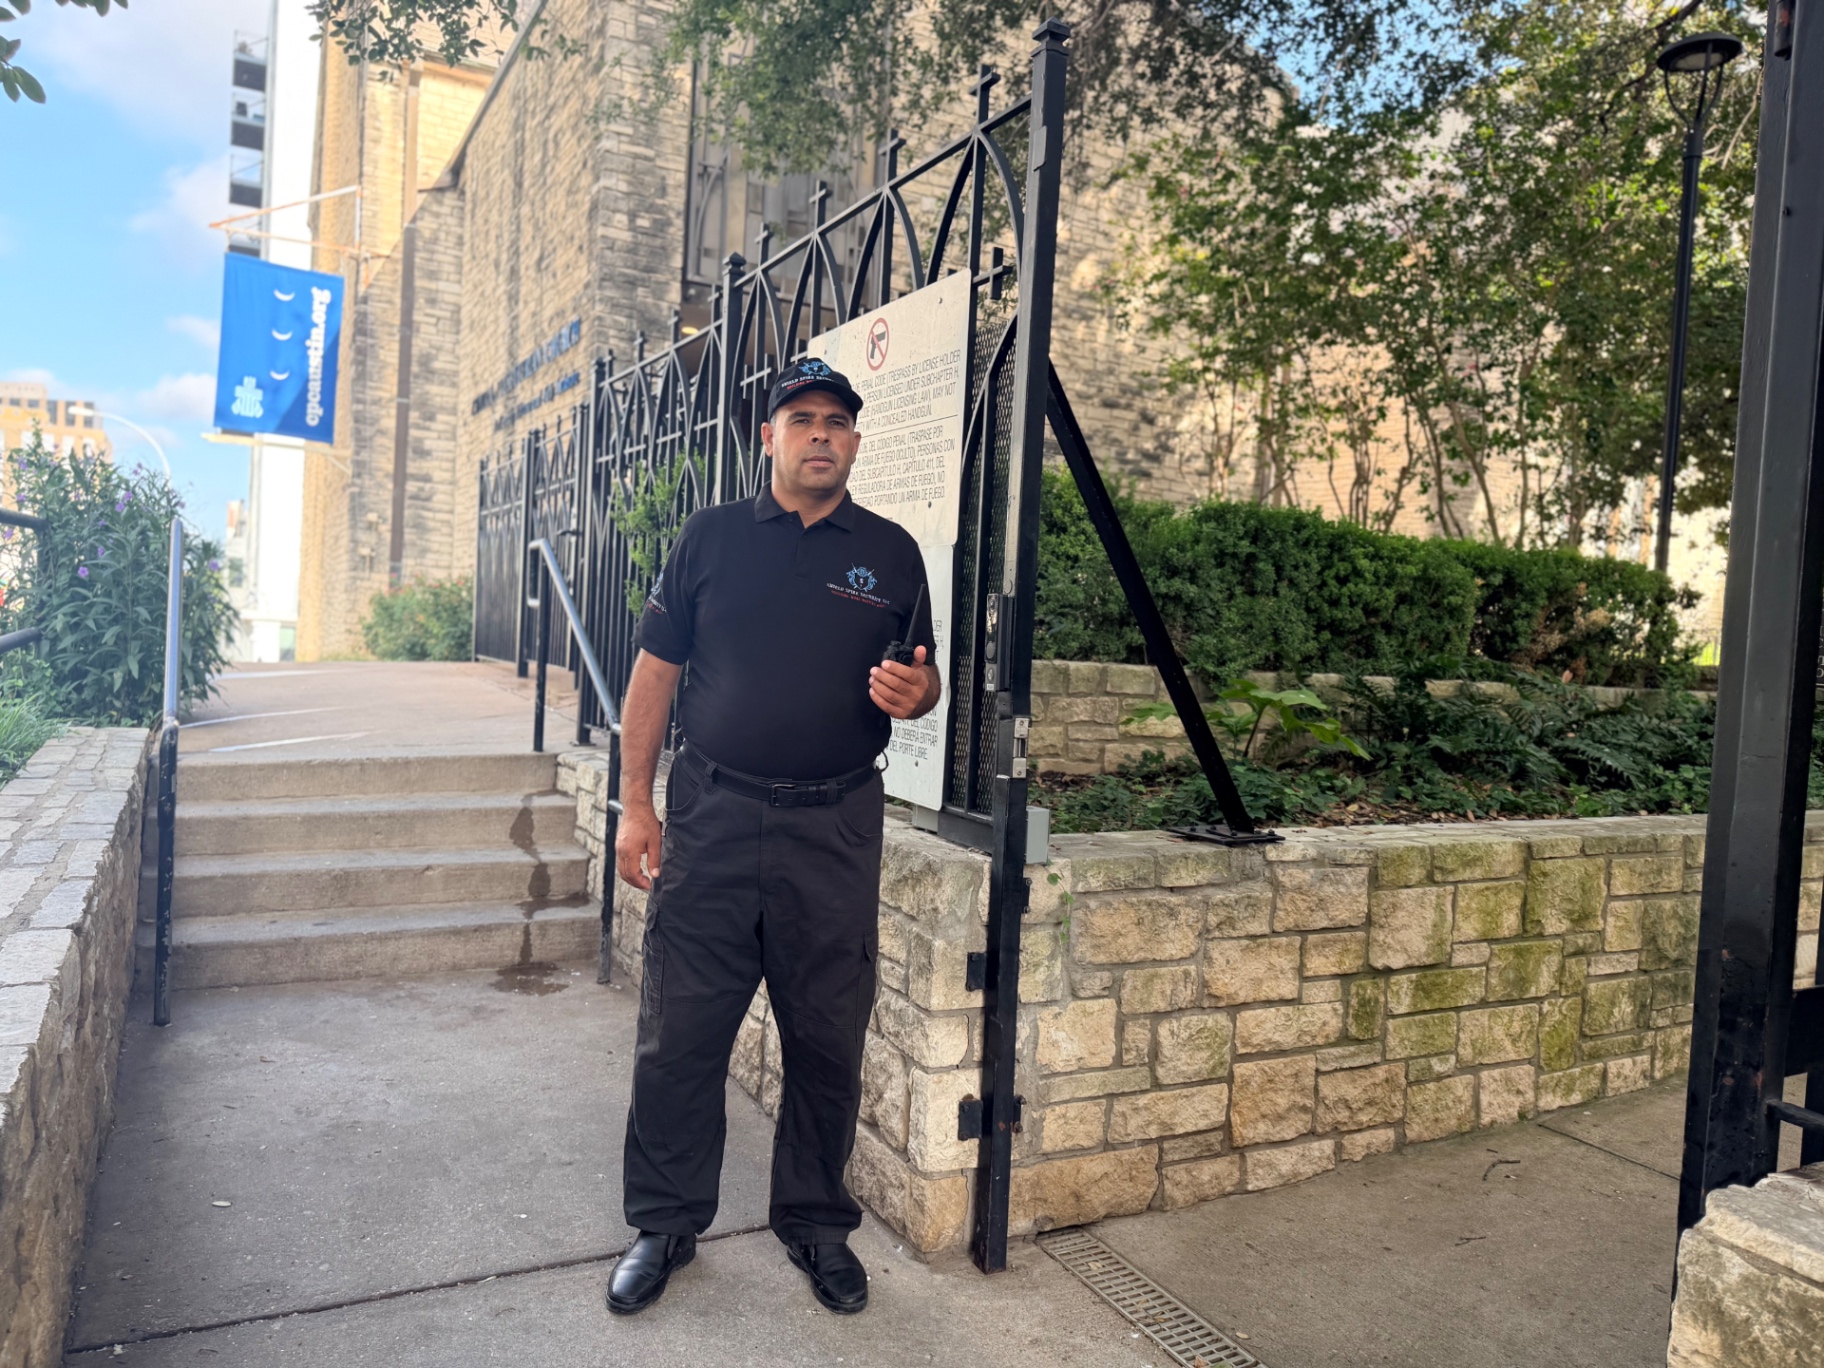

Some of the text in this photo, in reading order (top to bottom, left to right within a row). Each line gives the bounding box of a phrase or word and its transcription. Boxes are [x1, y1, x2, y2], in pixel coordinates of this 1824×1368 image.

[306, 286, 331, 427] cpcaustin.org
[874, 373, 887, 388] CODE
[911, 363, 919, 377] BY
[918, 356, 940, 374] LICENSE
[939, 349, 961, 367] HOLDER
[904, 377, 921, 393] UNDER
[920, 366, 953, 388] SUBCHAPTER
[893, 393, 917, 411] LICENSING
[932, 385, 944, 400] MAY
[944, 382, 957, 396] NOT
[881, 410, 907, 428] CONCEALED
[868, 440, 876, 452] DEL
[932, 425, 944, 439] POR
[874, 453, 880, 465] DE
[916, 440, 943, 457] PERSONAS
[935, 455, 945, 468] DEL
[886, 478, 893, 491] DE
[892, 476, 910, 489] ARMAS
[910, 475, 918, 487] DE
[937, 470, 945, 483] NO
[921, 488, 928, 500] DE
[889, 739, 898, 753] DEL
[899, 741, 914, 757] PORTE
[919, 731, 939, 748] ENTRAR
